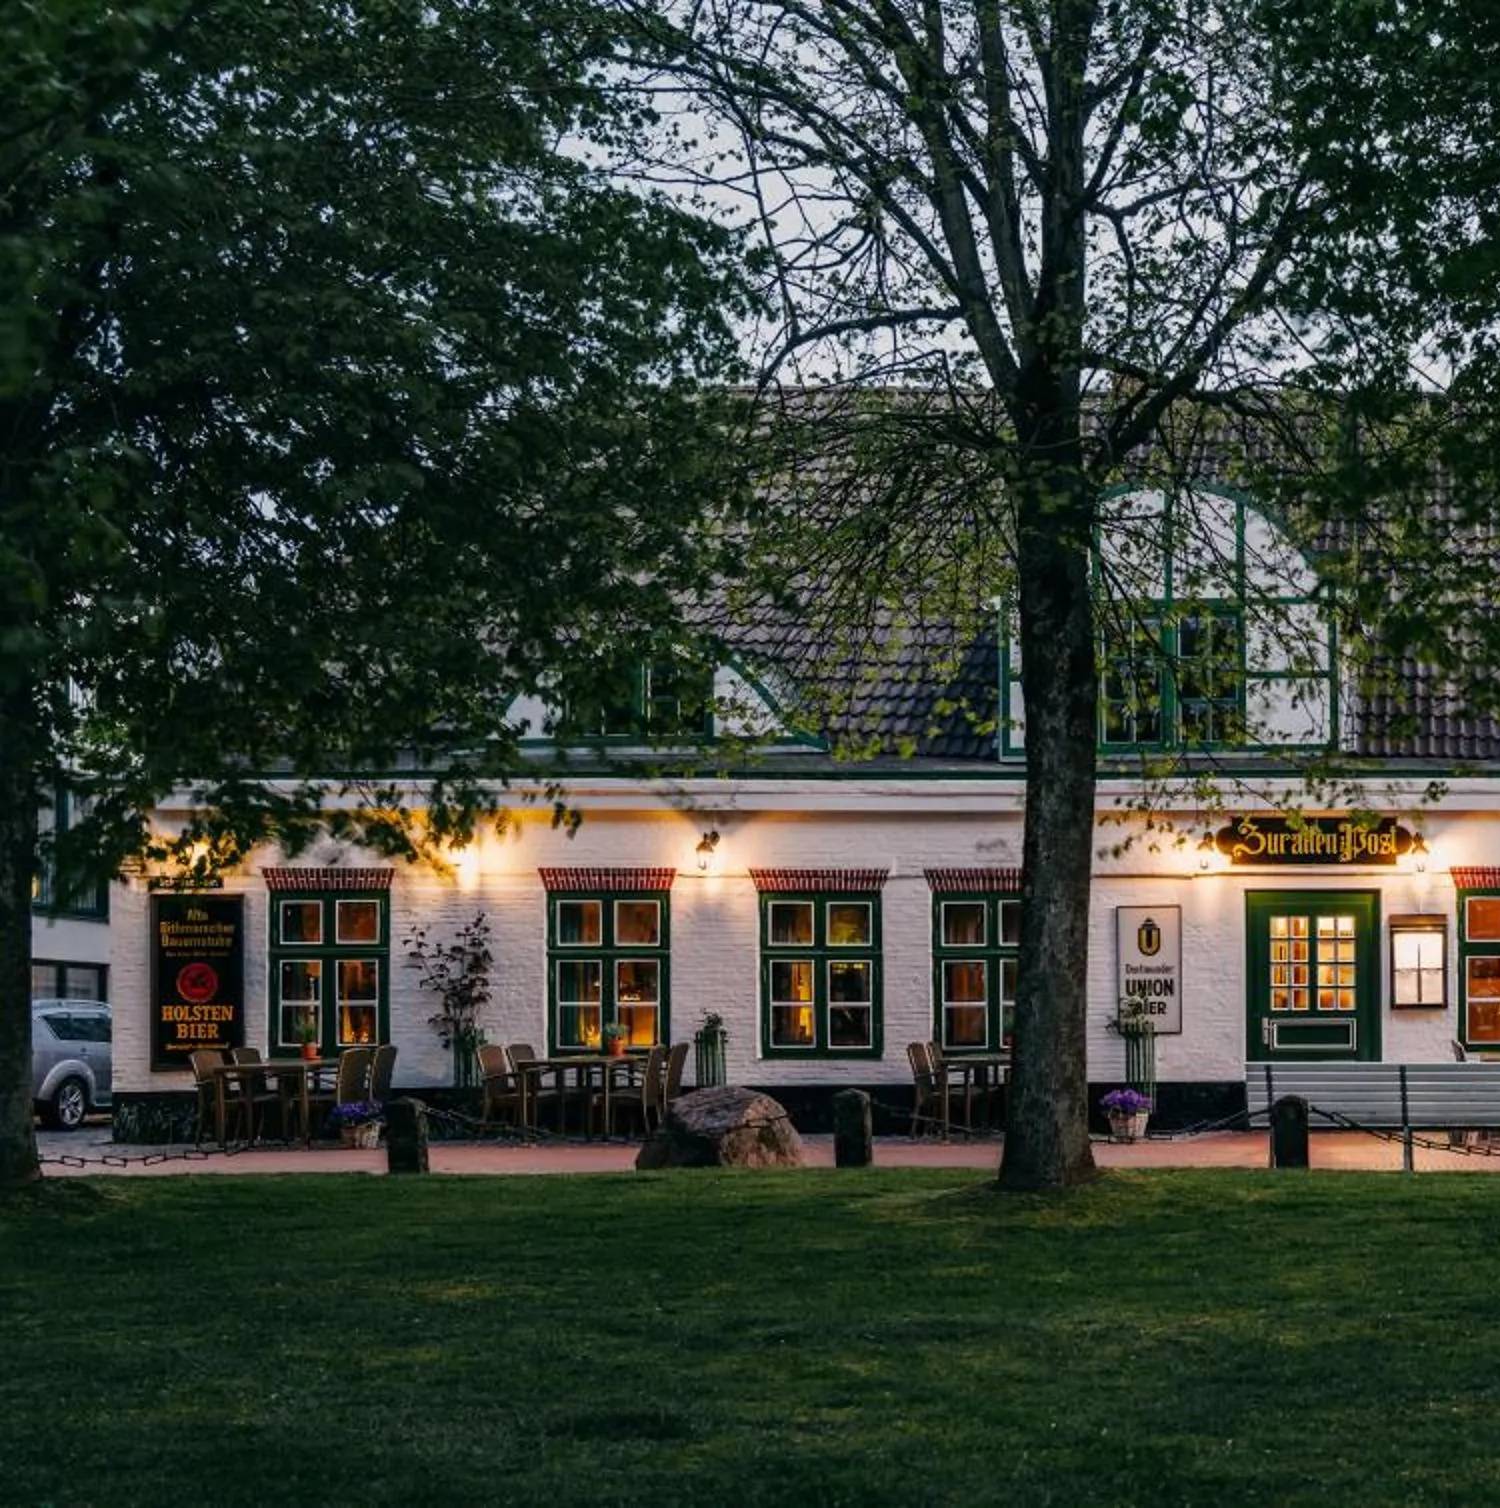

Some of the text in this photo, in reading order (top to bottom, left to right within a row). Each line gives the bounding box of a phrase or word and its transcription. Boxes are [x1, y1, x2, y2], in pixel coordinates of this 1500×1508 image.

[1338, 823, 1397, 862] Post
[1125, 978, 1175, 998] UNION
[161, 1005, 235, 1022] HOLSTEN
[175, 1023, 220, 1040] BIER
